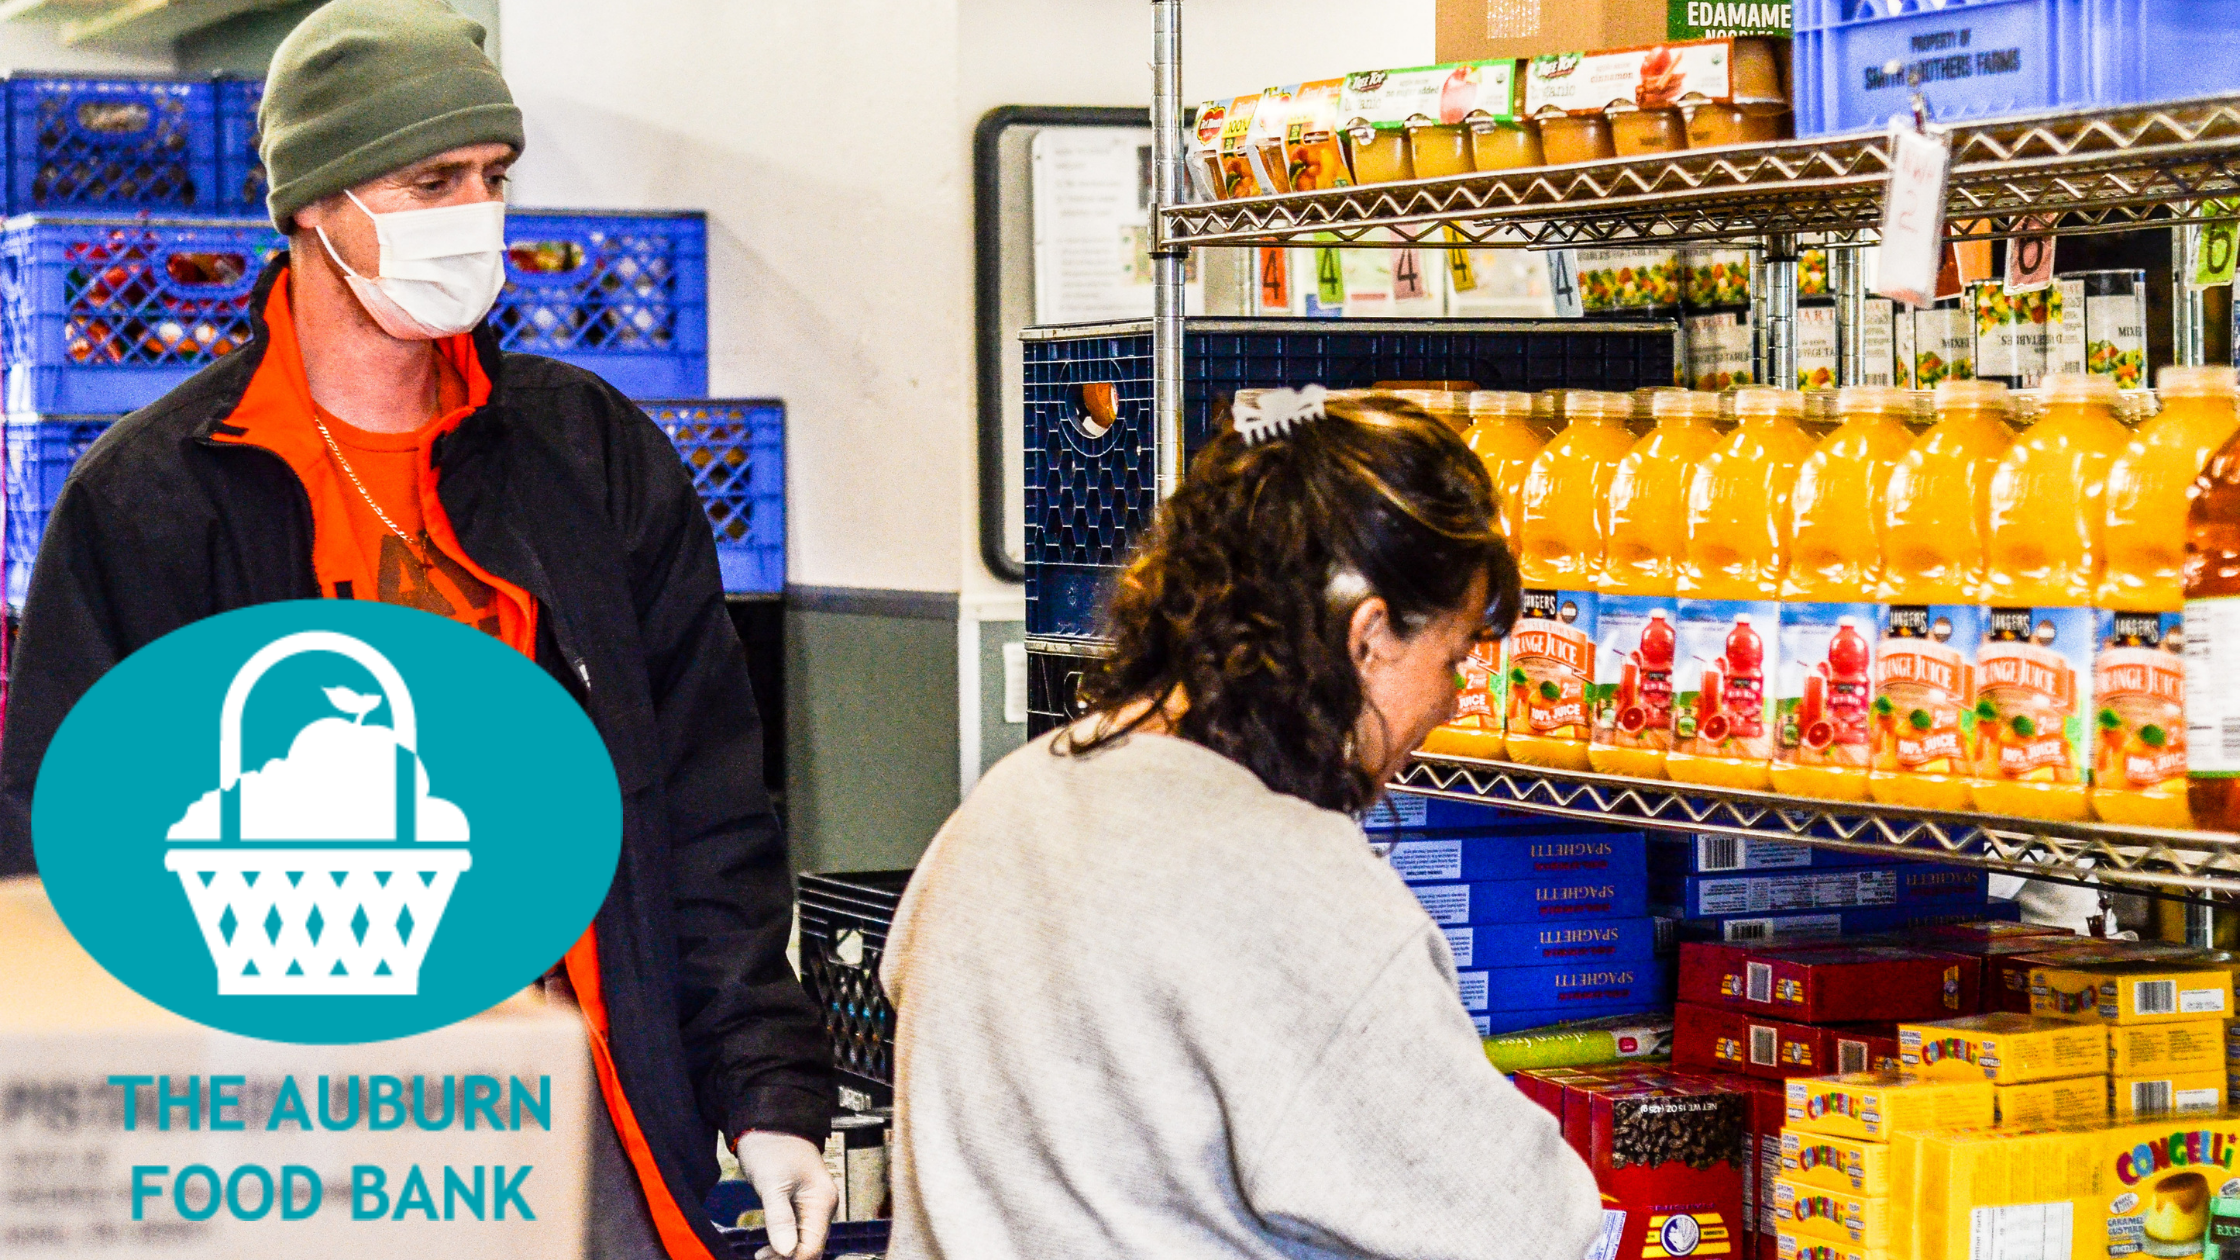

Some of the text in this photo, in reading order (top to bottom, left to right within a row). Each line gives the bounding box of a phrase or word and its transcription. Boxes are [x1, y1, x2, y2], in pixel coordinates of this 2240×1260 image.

[1687, 1, 1792, 28] EDAMAME
[1263, 250, 1280, 299] 4
[1320, 247, 1338, 294] 4
[1397, 249, 1417, 291] 4
[1556, 251, 1573, 306] 4
[1545, 632, 1578, 665] JUICE
[1914, 654, 1952, 690] JUICE
[1459, 694, 1486, 709] JUICE
[1553, 703, 1581, 719] JUICE
[1924, 734, 1957, 752] JUICE
[1530, 842, 1613, 858] SPAGHETTI
[1535, 884, 1616, 901] SPAGHETTI
[1539, 927, 1619, 944] SPAGHETTI
[1555, 970, 1634, 987] SPAGHETTI
[1665, 1104, 1678, 1113] OZ
[1678, 1104, 1687, 1112] 15
[1702, 1103, 1717, 1111] NET
